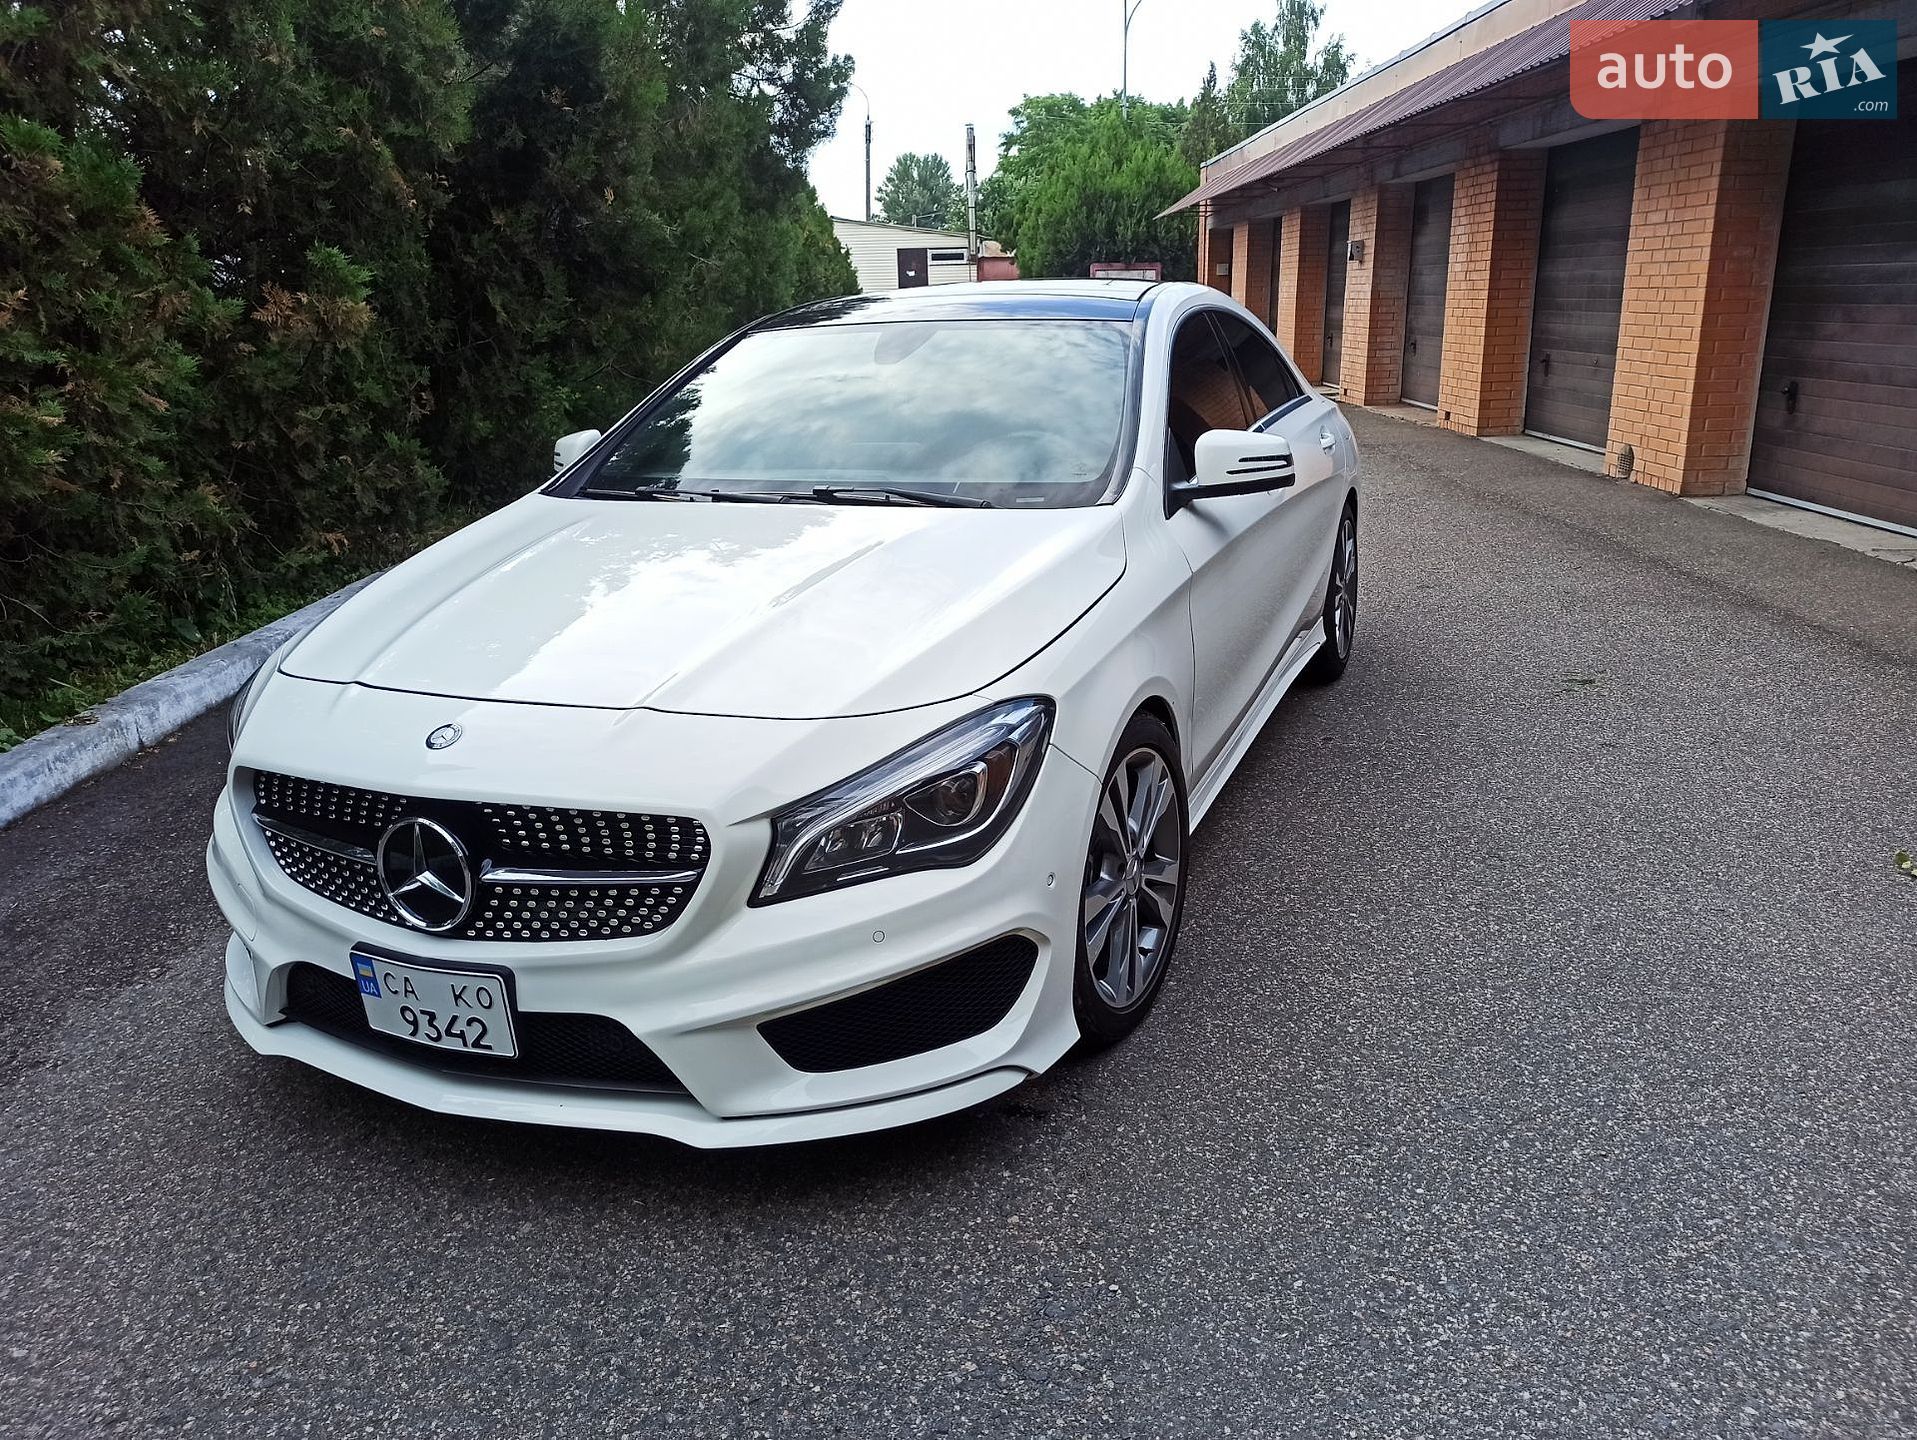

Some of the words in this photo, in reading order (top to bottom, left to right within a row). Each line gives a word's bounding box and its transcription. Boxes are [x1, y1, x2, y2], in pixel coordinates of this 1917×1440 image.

[361, 980, 377, 994] UA
[383, 971, 420, 1001] CA
[450, 983, 493, 1009] KO
[399, 1005, 492, 1050] 9342
